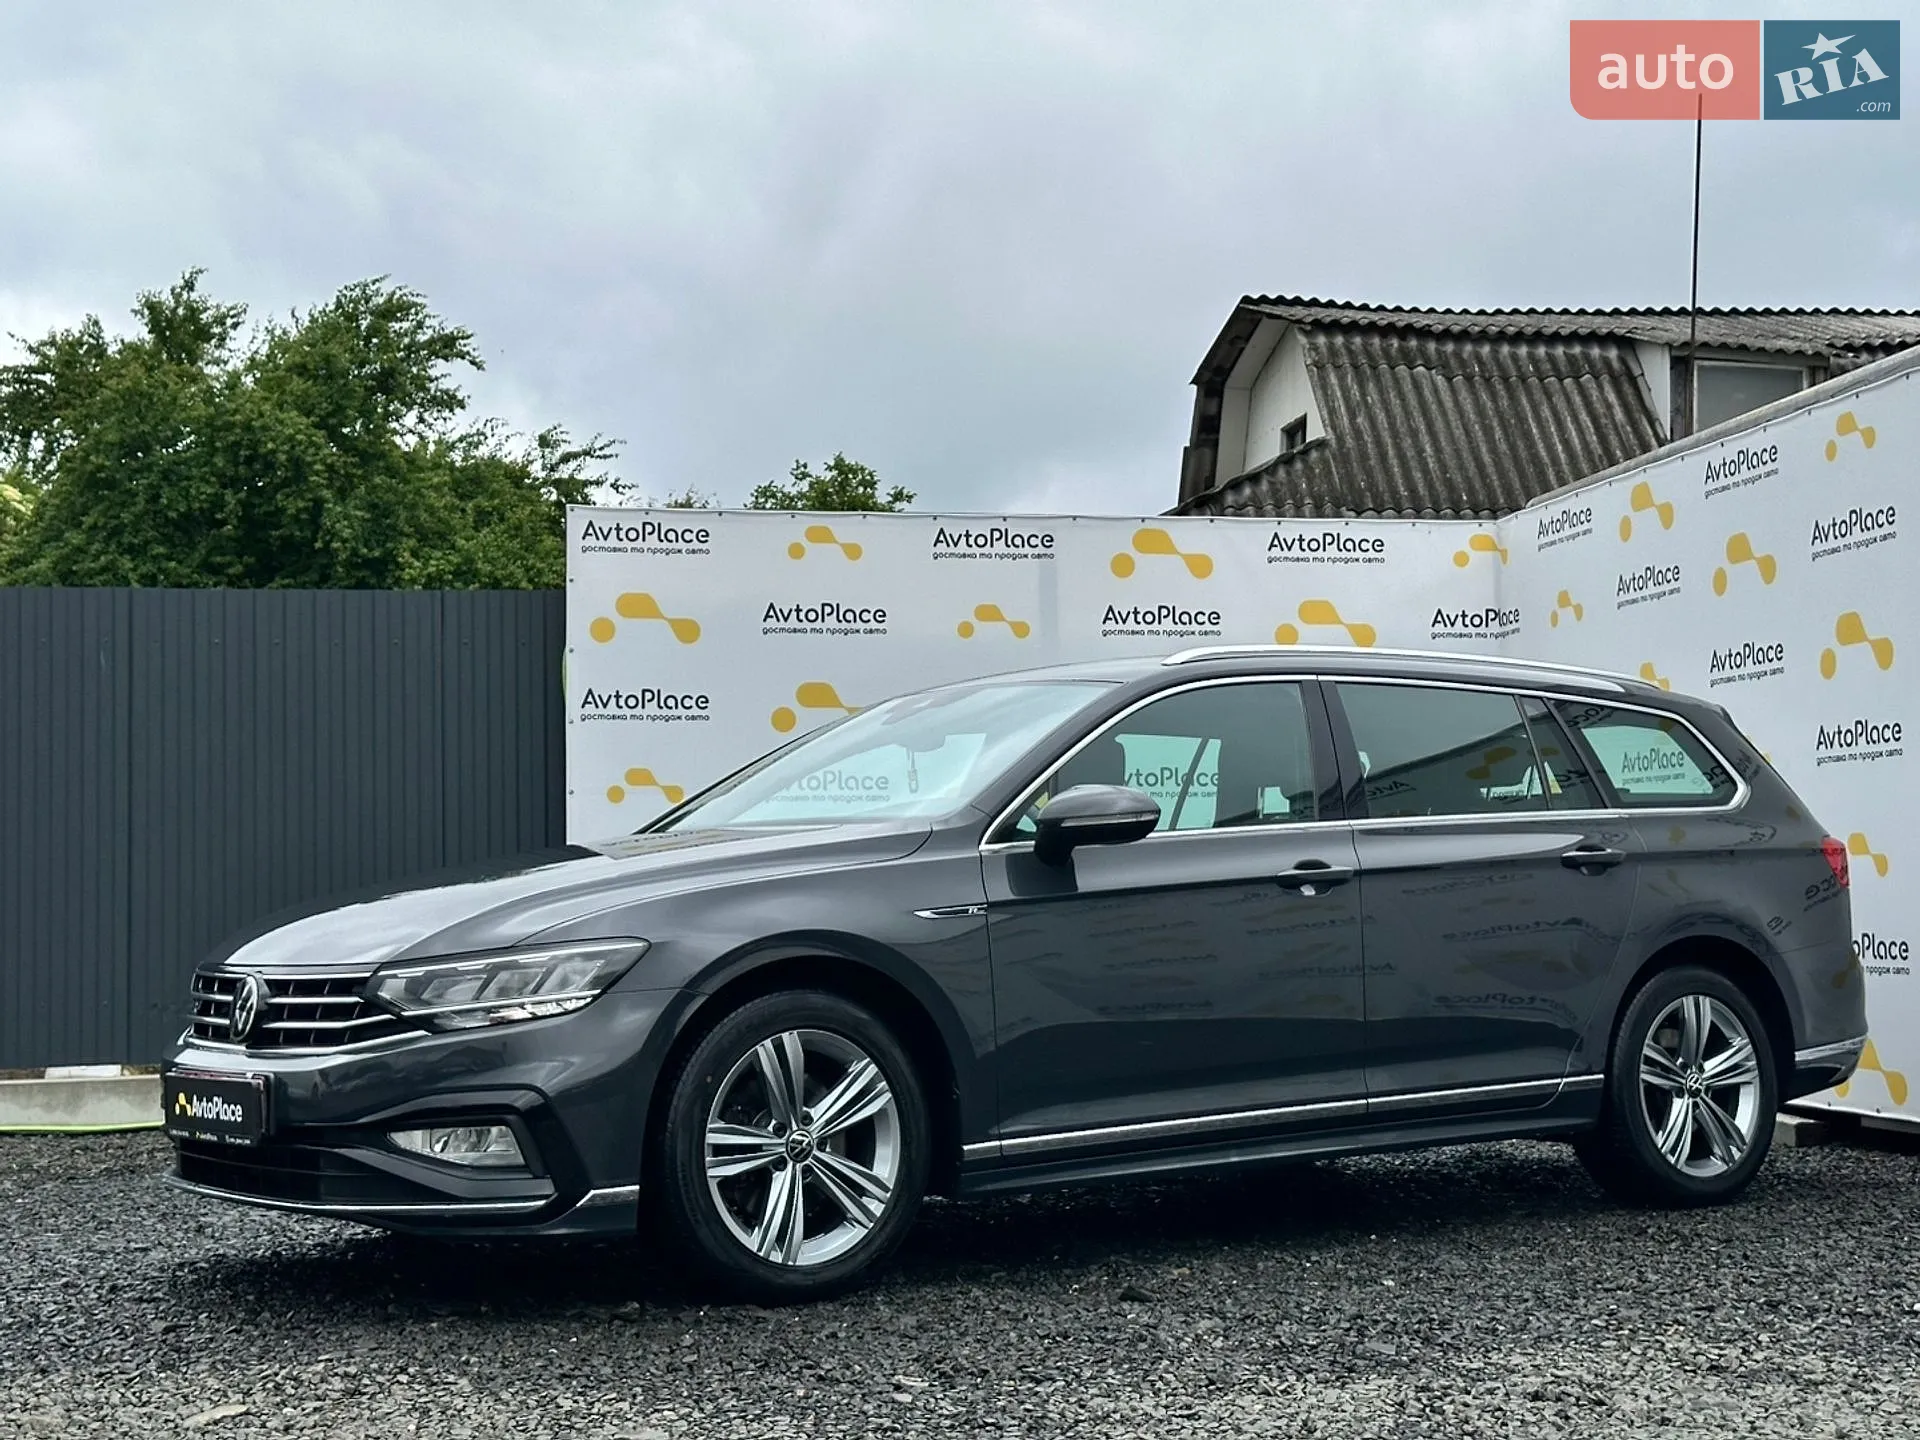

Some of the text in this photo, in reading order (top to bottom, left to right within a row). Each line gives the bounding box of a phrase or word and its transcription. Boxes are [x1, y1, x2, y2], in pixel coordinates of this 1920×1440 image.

[1704, 445, 1778, 485] AvtoPlace
[581, 520, 710, 544] AvtoPlace
[1537, 507, 1592, 540] AvtoPlace
[1811, 506, 1896, 546] AvtoPlace
[933, 527, 1055, 549] AvtoPlace
[1267, 532, 1385, 552] AvtoPlace
[581, 545, 628, 554] доставка
[646, 547, 683, 556] продаж
[932, 552, 977, 560] доставка
[994, 552, 1029, 561] продаж
[1267, 556, 1310, 564] доставка
[1327, 557, 1360, 565] продаж
[1617, 565, 1680, 596] AvtoPlace
[762, 602, 887, 624] AvtoPlace
[1102, 604, 1221, 625] AvtoPlace
[1431, 608, 1520, 628] AvtoPlace
[762, 627, 808, 635] доставка
[825, 627, 861, 636] продаж
[1101, 628, 1145, 637] доставка
[1162, 629, 1196, 638] продаж
[1710, 641, 1783, 673] AvtoPlace
[580, 688, 710, 710] AvtoPlace
[580, 713, 627, 722] доставка
[646, 713, 683, 723] продаж
[1816, 719, 1902, 751] AvtoPlace
[1621, 747, 1684, 773] AvtoPlace
[191, 1094, 243, 1122] AvtoPlace
